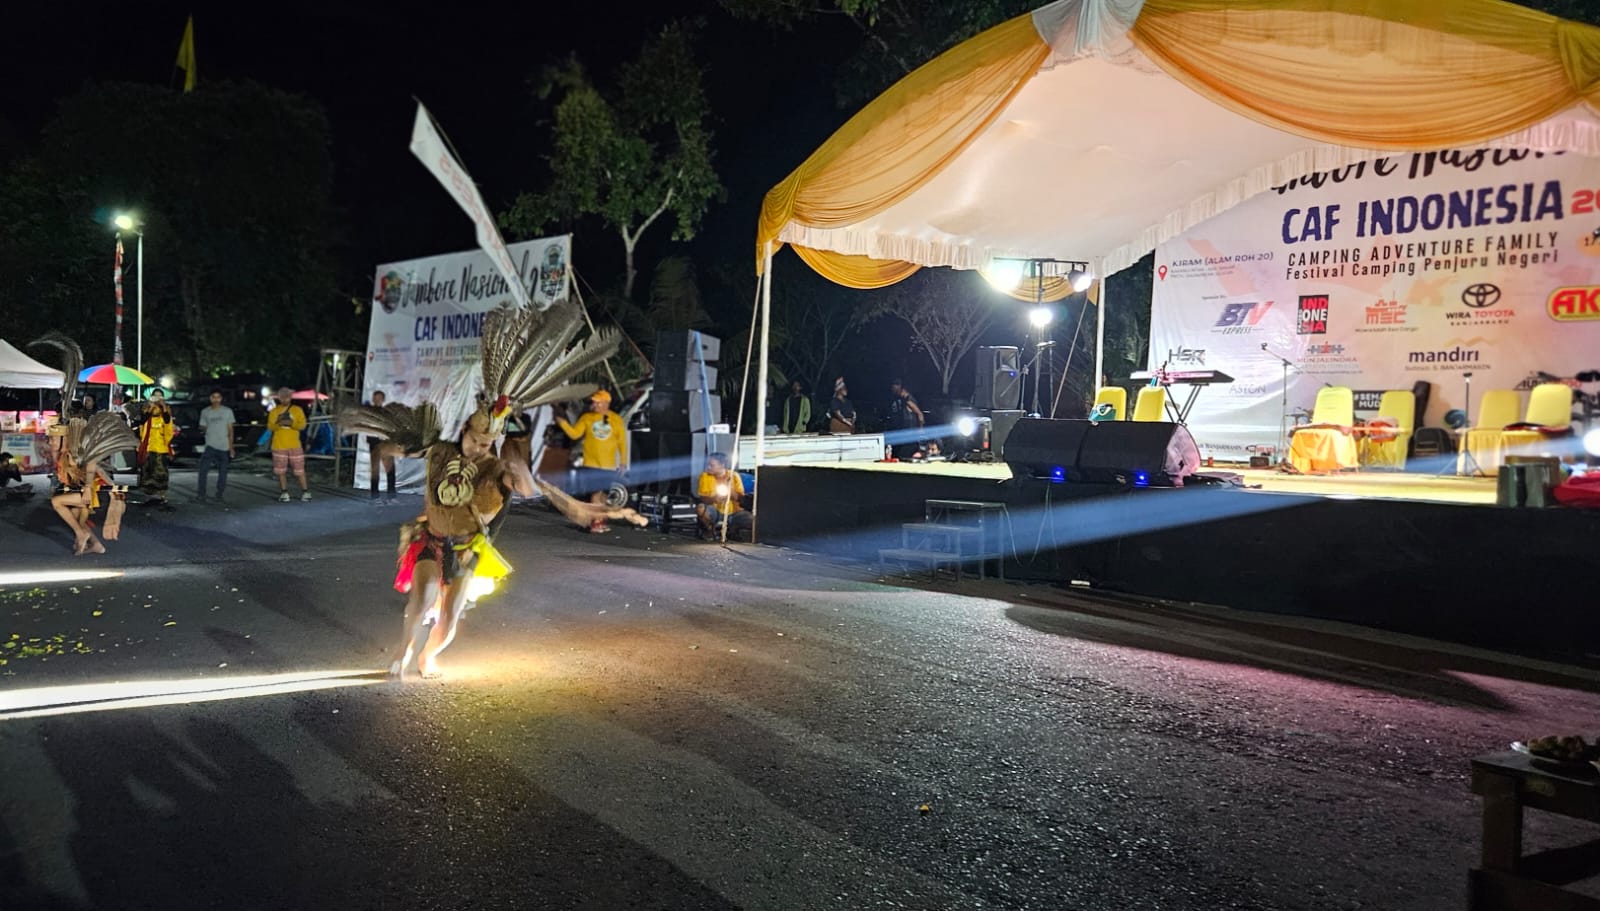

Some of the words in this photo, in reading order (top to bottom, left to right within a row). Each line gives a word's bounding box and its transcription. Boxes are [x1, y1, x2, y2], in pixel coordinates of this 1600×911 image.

[1282, 204, 1340, 244] CAF
[1356, 180, 1564, 237] INDONESIA
[1571, 189, 1600, 214] 2
[1288, 248, 1360, 267] CAMPING
[1371, 238, 1475, 261] ADVENTURE
[1485, 231, 1558, 252] FAMILY
[1172, 259, 1202, 267] KIRAM
[1205, 255, 1232, 265] (ALAM
[1258, 252, 1274, 261] 20)
[1286, 264, 1344, 280] Festival
[1352, 261, 1415, 277] Camping
[1424, 255, 1488, 272] Penjuru
[1497, 249, 1558, 267] Negeri
[461, 249, 530, 303] Nasionl
[1302, 298, 1328, 309] IND
[1215, 301, 1274, 327] BTV
[1302, 309, 1327, 321] ONE
[1475, 309, 1515, 318] TOYOTA
[415, 316, 437, 341] CAF
[442, 312, 485, 340] INDONE
[1302, 321, 1325, 332] SIA
[1409, 347, 1480, 363] mandiri
[1359, 400, 1381, 408] MUD
